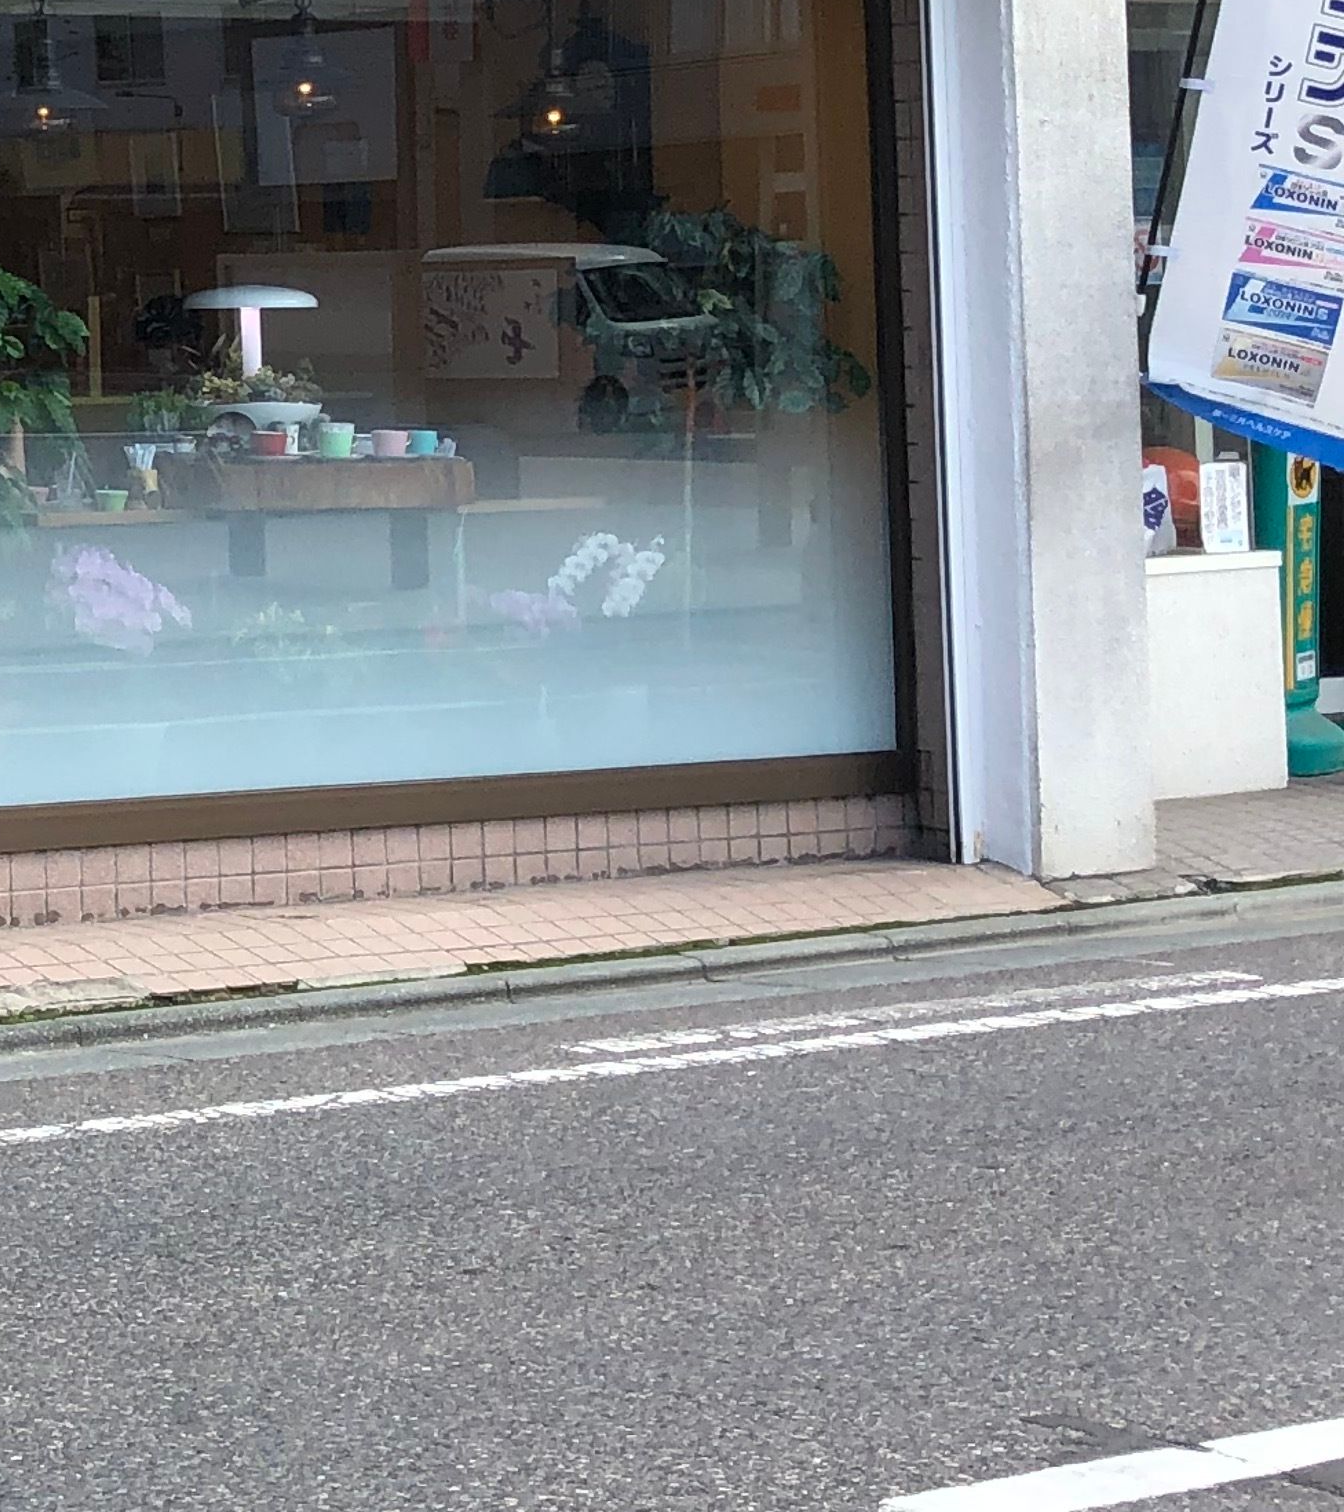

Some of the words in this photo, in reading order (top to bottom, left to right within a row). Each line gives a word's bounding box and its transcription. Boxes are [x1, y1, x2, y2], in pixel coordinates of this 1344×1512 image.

[1251, 55, 1293, 155] シリーズ
[1264, 186, 1338, 212] LOXONIN
[1244, 234, 1313, 260] LOXONIN
[1240, 290, 1315, 316] LOXONIN
[1228, 348, 1300, 373] LOXONIN
